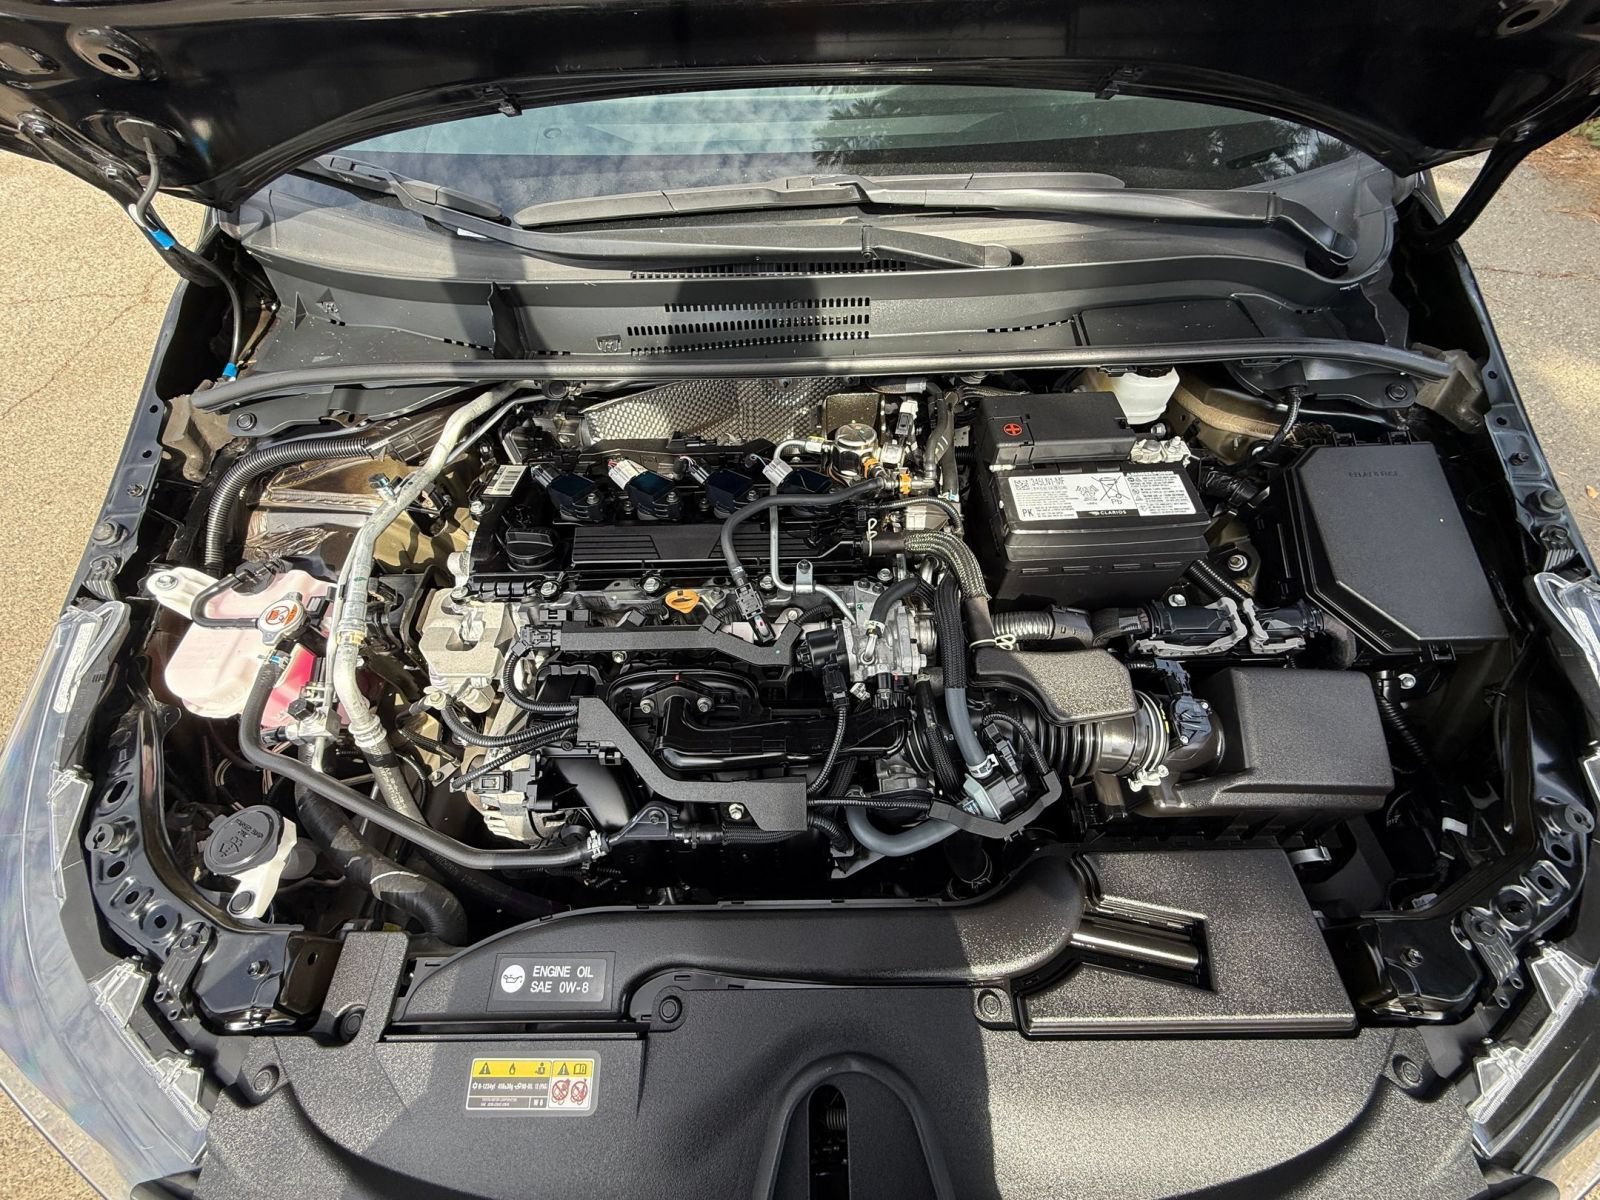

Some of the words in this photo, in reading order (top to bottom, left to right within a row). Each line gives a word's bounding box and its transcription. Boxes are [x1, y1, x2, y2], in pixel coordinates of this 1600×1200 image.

[1022, 508, 1034, 517] PK
[532, 965, 571, 977] ENGINE
[577, 966, 594, 978] OIL
[530, 981, 552, 993] SAE
[559, 981, 589, 993] 0W-8
